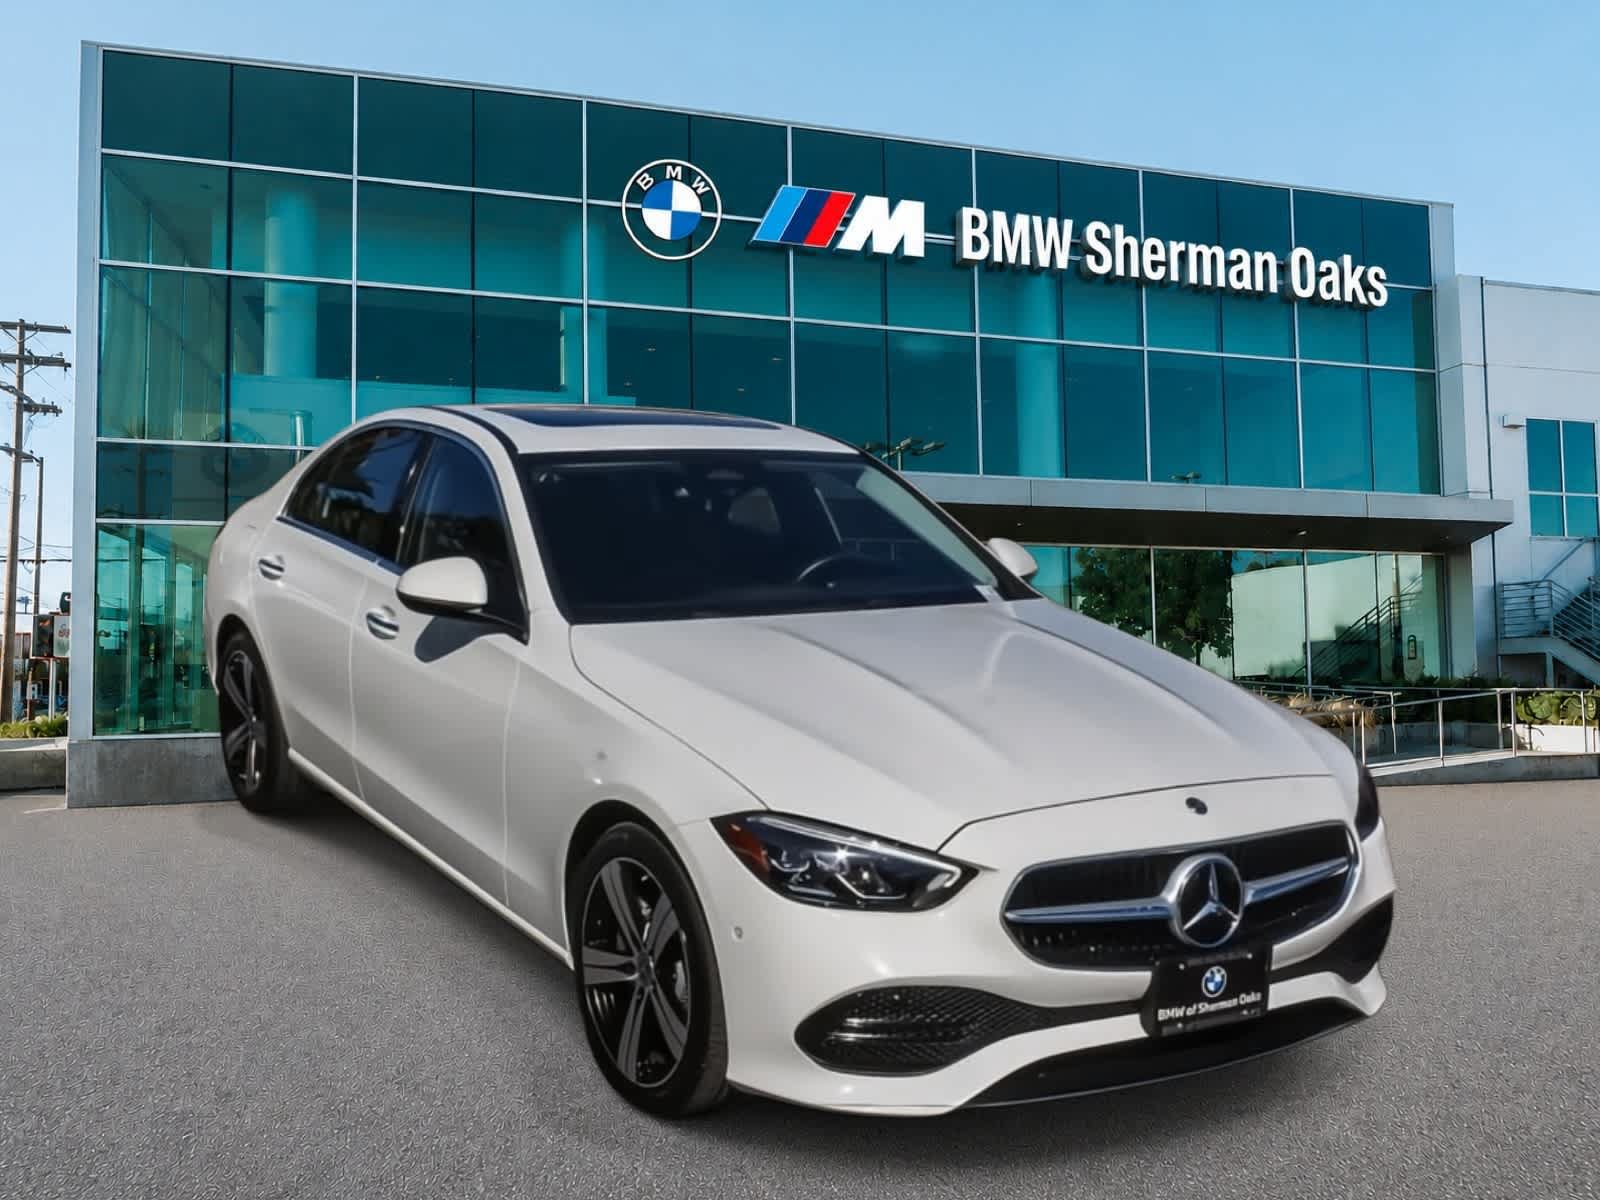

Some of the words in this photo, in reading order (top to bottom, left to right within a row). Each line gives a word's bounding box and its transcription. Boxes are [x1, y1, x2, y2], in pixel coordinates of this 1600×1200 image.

[636, 164, 710, 196] BMW
[836, 195, 925, 258] M
[961, 206, 1073, 270] BMW
[1084, 220, 1278, 294] Sherman
[1290, 246, 1389, 308] Oaks
[1157, 1006, 1186, 1021] BMW
[1239, 991, 1262, 1005] Oaks
